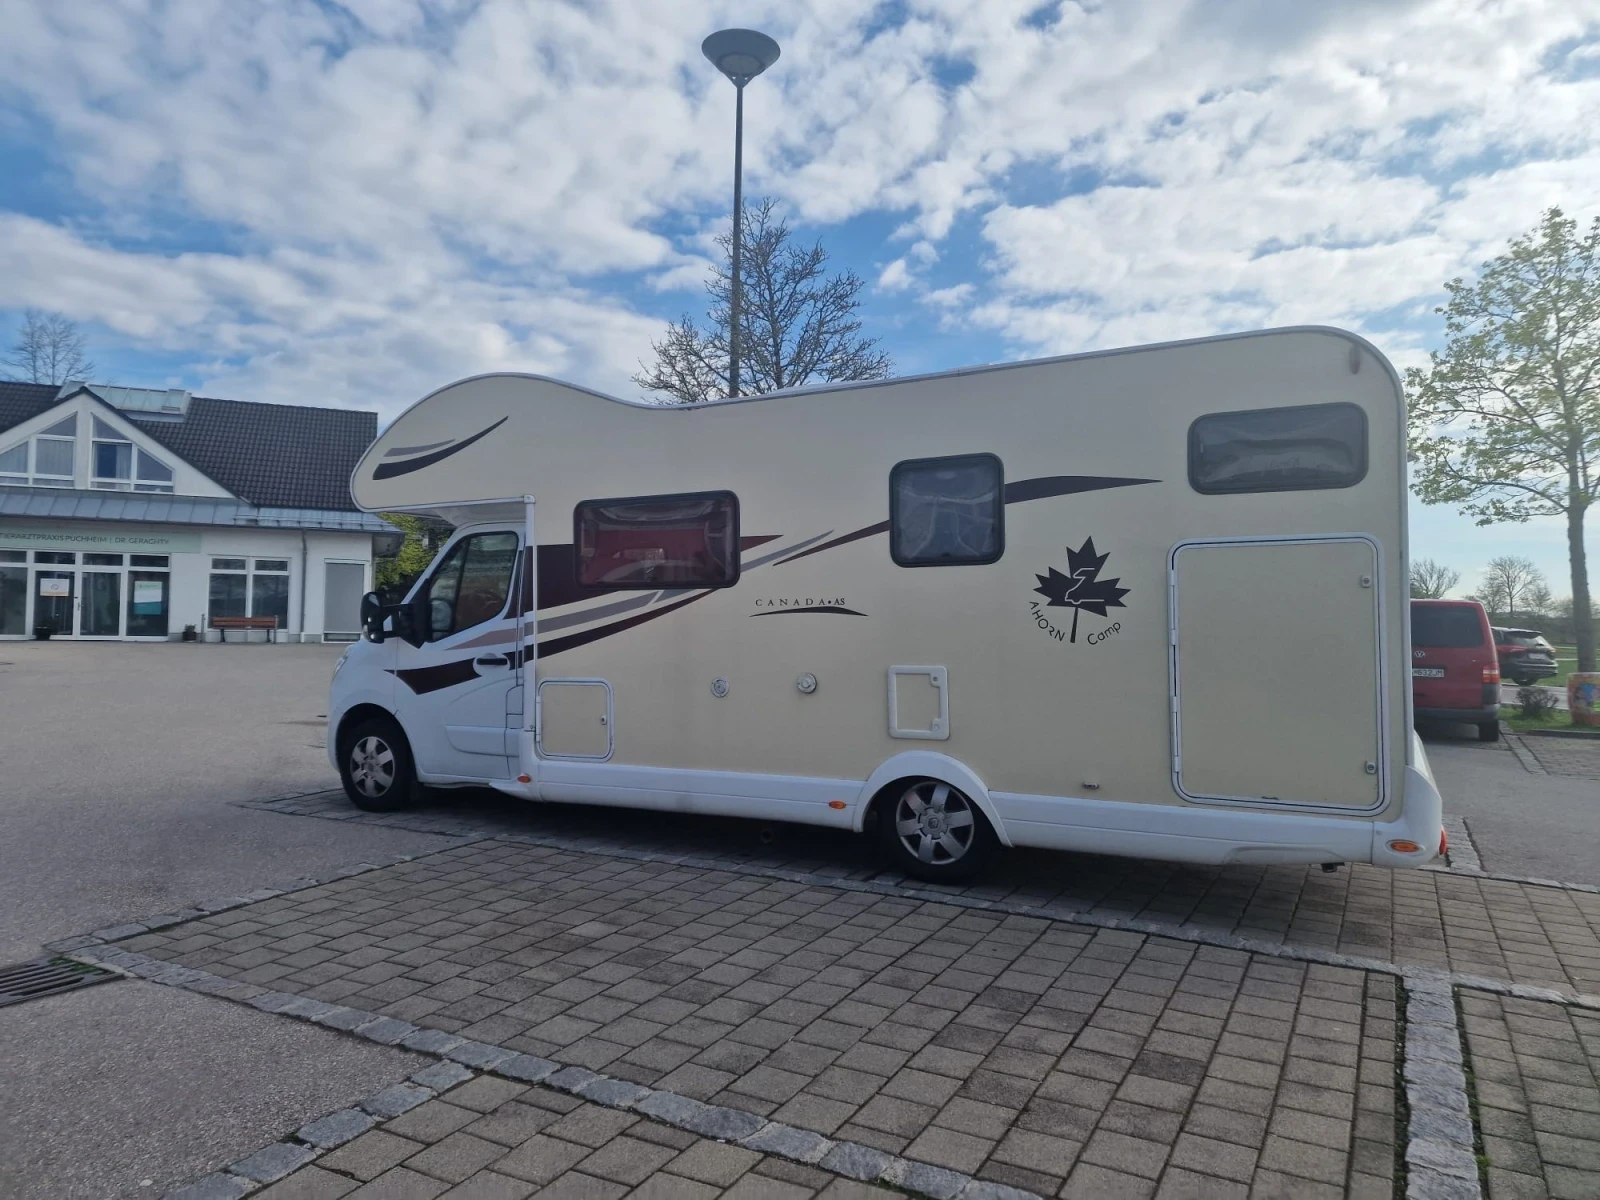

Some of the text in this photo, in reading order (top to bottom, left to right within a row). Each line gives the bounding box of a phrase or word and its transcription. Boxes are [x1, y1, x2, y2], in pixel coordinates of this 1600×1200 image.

[65, 534, 108, 543] PUCHHEIM
[1029, 601, 1121, 645] AHORN Camp
